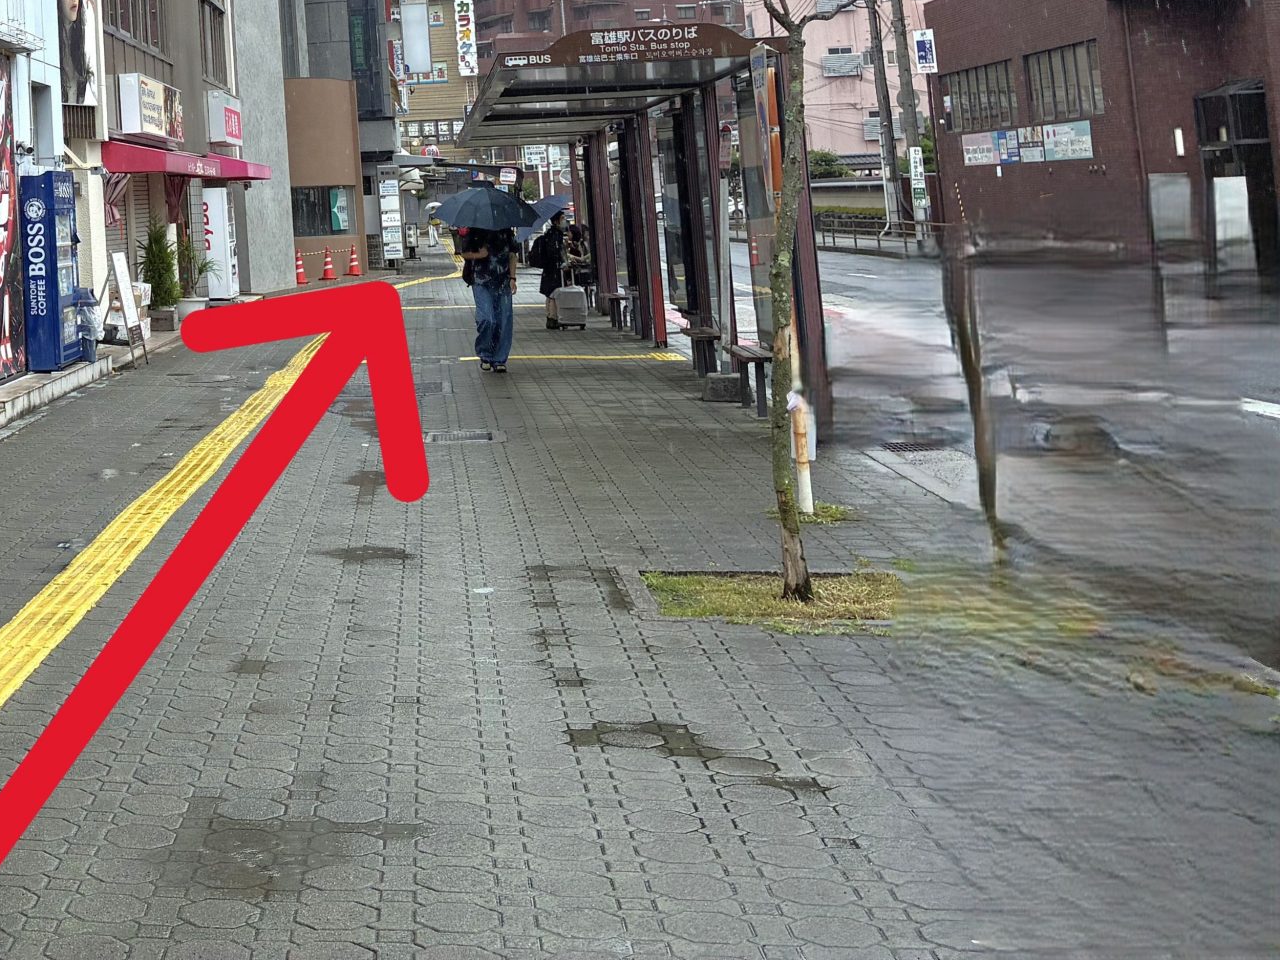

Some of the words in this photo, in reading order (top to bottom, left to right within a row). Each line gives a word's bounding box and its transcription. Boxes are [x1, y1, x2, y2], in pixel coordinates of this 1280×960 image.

[590, 26, 698, 45] 富雄駅バスのりば
[600, 44, 628, 54] Tomio
[630, 43, 648, 52] Sta.
[650, 42, 668, 50] Bus
[670, 40, 691, 50] stop
[528, 53, 552, 65] BUS
[26, 222, 46, 277] BOSS
[29, 279, 38, 316] SUNTORY
[37, 279, 47, 316] COFFEE
